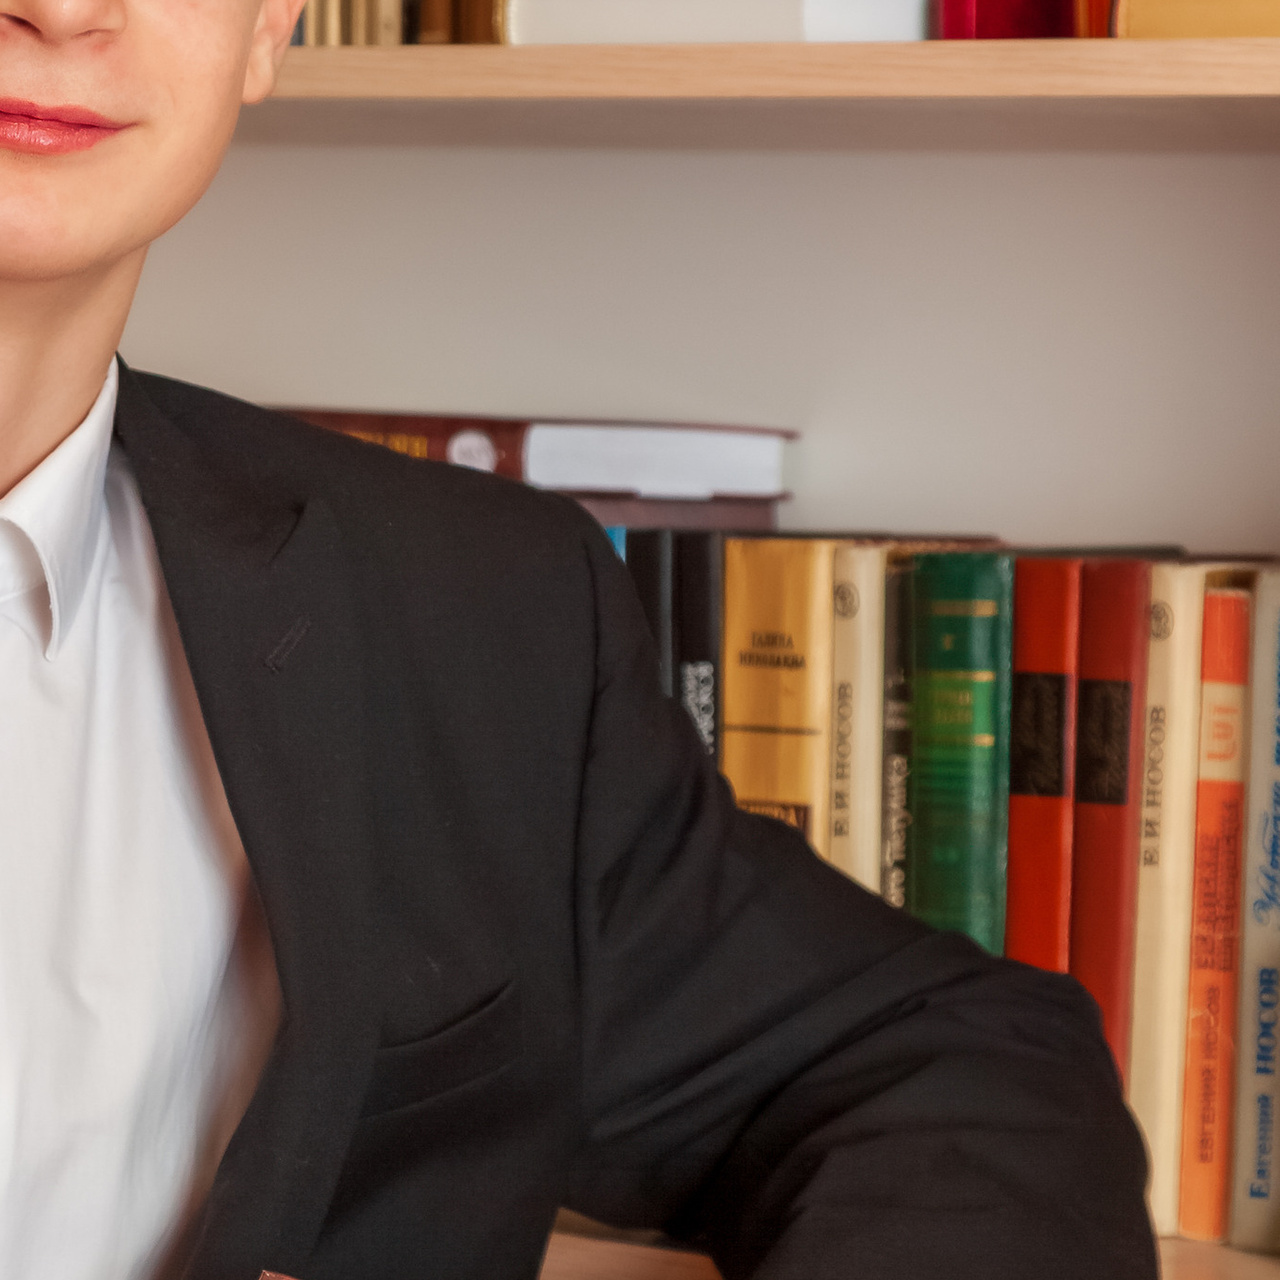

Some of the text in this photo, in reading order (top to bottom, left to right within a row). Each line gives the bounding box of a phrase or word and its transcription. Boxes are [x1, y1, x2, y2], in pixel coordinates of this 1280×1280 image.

[835, 681, 853, 780] НОСОВ
[1145, 705, 1166, 808] НОСОВ
[1255, 968, 1280, 1076] НОСОВ
